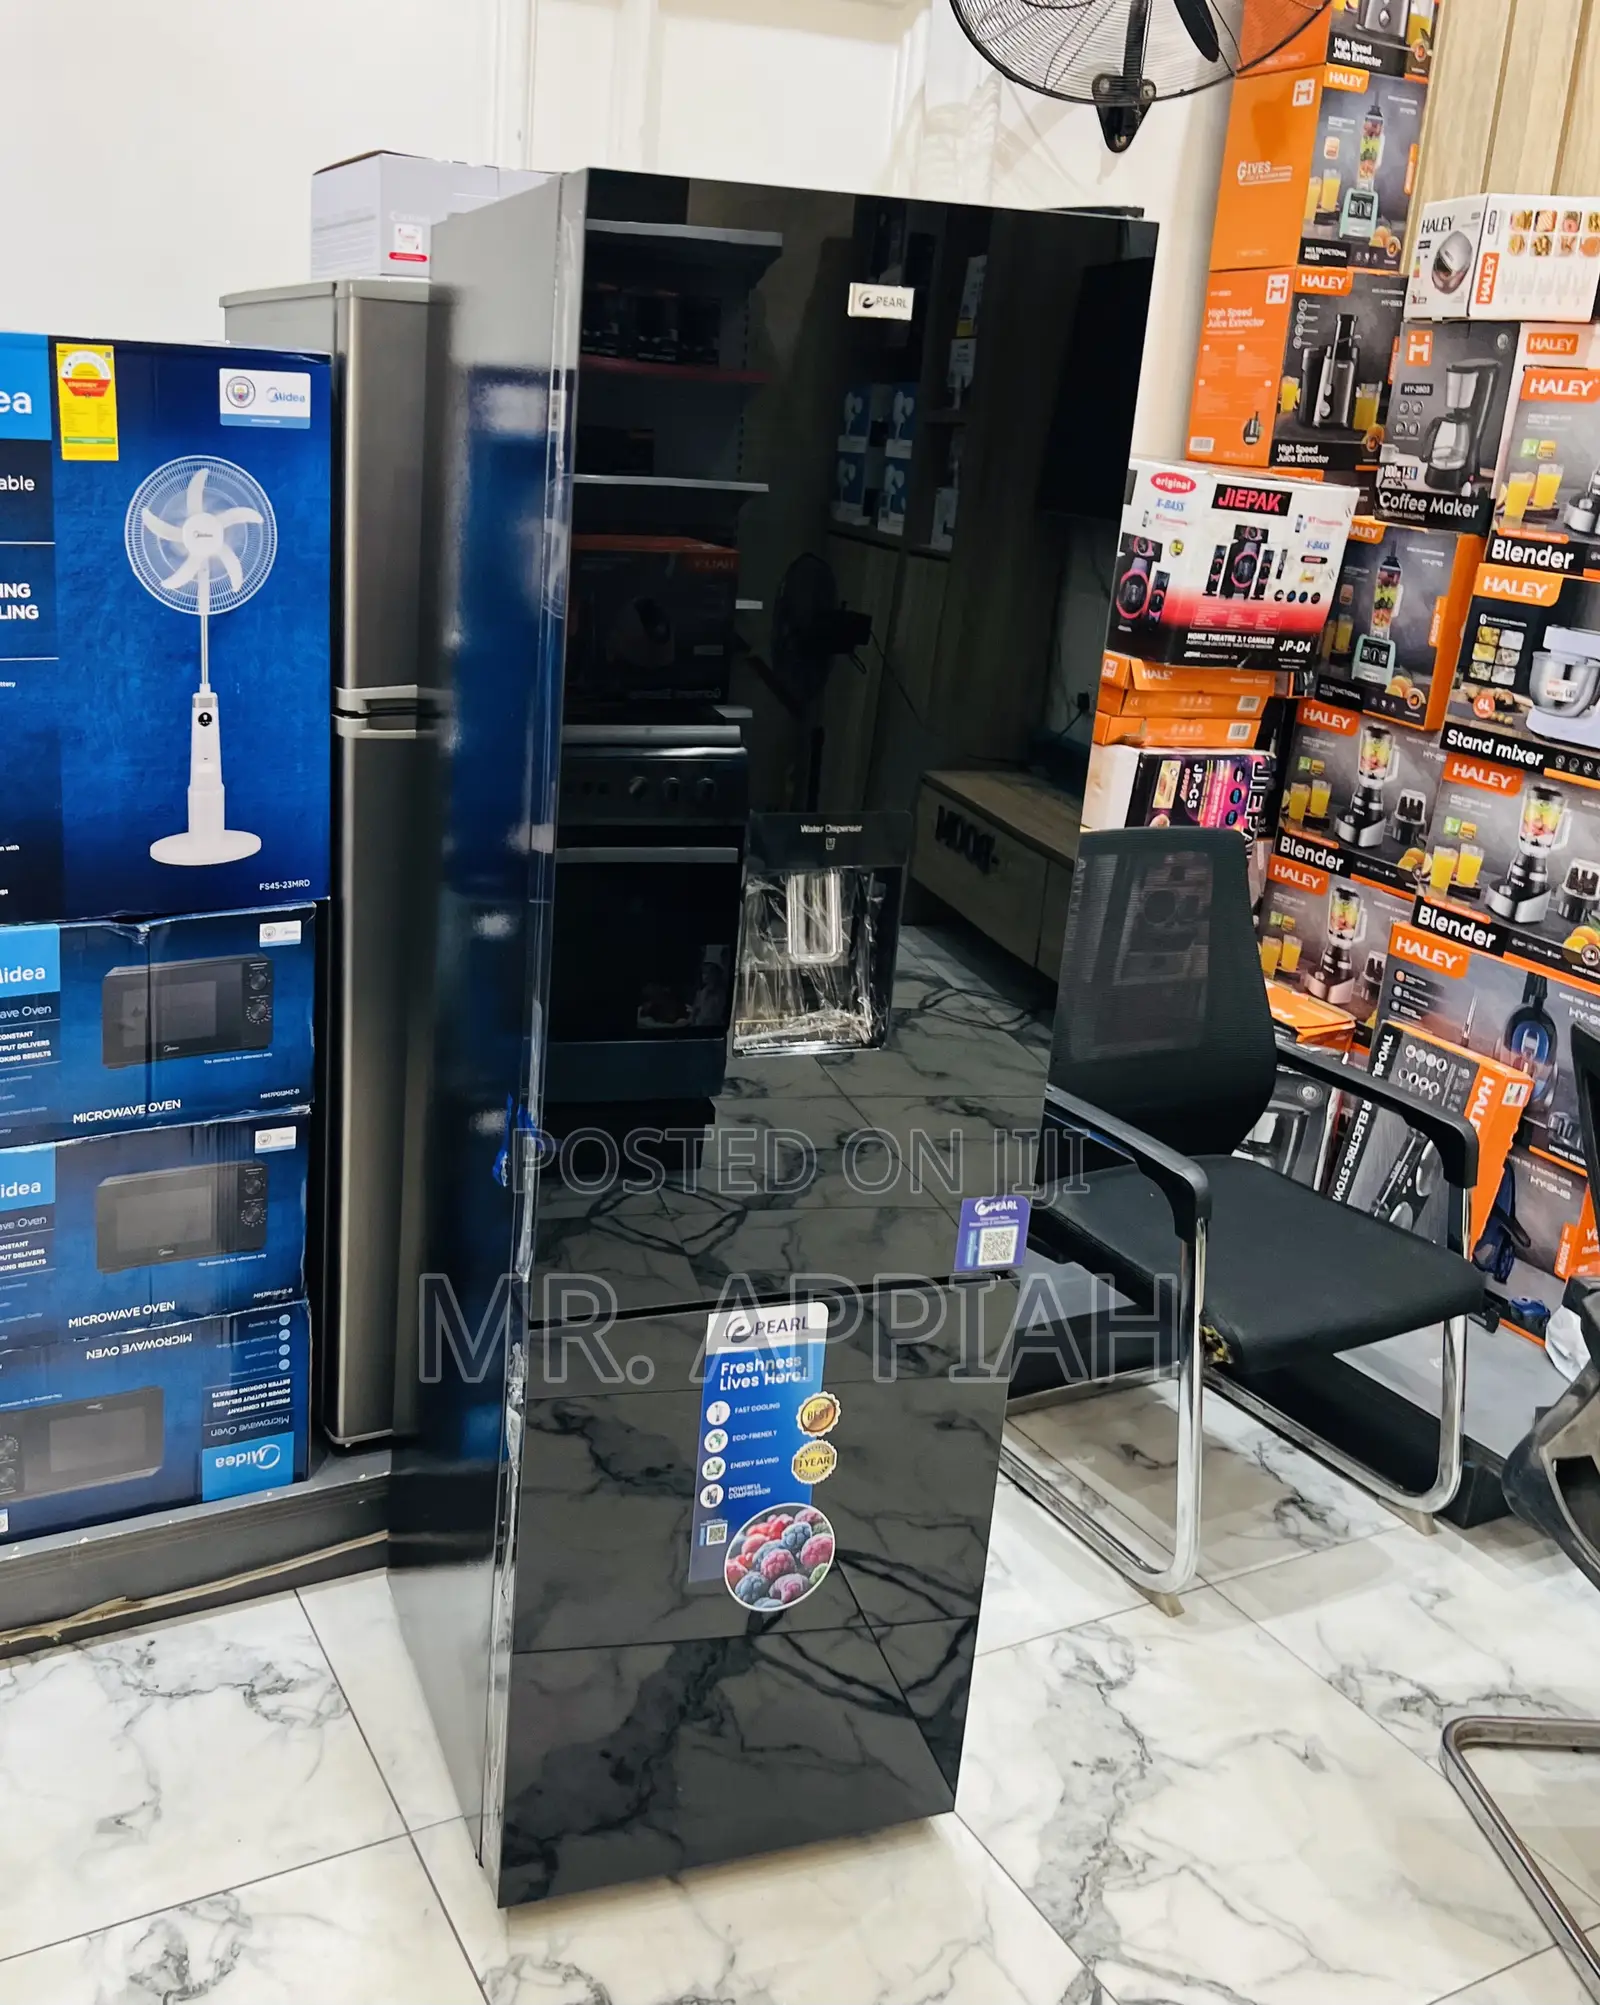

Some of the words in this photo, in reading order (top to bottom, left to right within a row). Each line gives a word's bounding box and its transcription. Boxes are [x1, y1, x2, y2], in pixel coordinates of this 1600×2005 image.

[1329, 72, 1364, 88] HALEY
[1237, 160, 1271, 180] GIVES
[1421, 215, 1455, 233] HALEY
[1301, 275, 1346, 290] HALEY
[1480, 256, 1496, 301] HALEY
[875, 295, 908, 309] PEARL
[1208, 308, 1226, 321] High
[1227, 307, 1252, 320] Speed
[1530, 337, 1574, 352] HALEY
[266, 387, 305, 404] Midea
[1529, 377, 1593, 397] HALEY
[1278, 444, 1295, 455] High
[1296, 445, 1319, 455] Speed
[1156, 477, 1191, 491] original
[1218, 487, 1282, 513] JIEPAK
[1379, 491, 1427, 512] Coffee
[1429, 497, 1479, 519] Maker
[1491, 538, 1575, 570] Blender
[1483, 575, 1548, 599] HALEY
[1279, 640, 1311, 653] JP-D4
[1142, 668, 1173, 680] HALE
[1303, 708, 1350, 730] HALEY
[1446, 728, 1495, 755] Stand
[1496, 743, 1544, 768] mixer
[1452, 761, 1512, 791] HALEY
[1187, 763, 1203, 809] JP-C5
[800, 825, 824, 834] Water
[825, 825, 862, 835] Dispenser
[1280, 836, 1344, 871] Blender
[259, 879, 310, 891] FS45-23MRD
[1274, 865, 1321, 888] HALEY
[1418, 905, 1497, 949] Blender
[1396, 936, 1457, 971] HALEY
[22, 1005, 52, 1016] Oven
[17, 1040, 50, 1050] DELIVERS
[22, 1050, 51, 1060] RESULTS
[73, 1103, 146, 1124] MICROWAVE
[147, 1099, 181, 1112] OVEN
[1344, 1113, 1369, 1167] ELECTRIC
[17, 1216, 47, 1228] Oven
[68, 1307, 141, 1329] MICROWAVE
[143, 1301, 176, 1315] OVEN
[754, 1316, 809, 1336] PEARL
[122, 1333, 192, 1353] MICROWAVE
[86, 1346, 120, 1360] OVEN
[721, 1356, 802, 1376] Freshness
[720, 1375, 759, 1391] Lives
[764, 1367, 808, 1386] Here!
[735, 1406, 750, 1414] FAST
[751, 1402, 780, 1413] COOLING
[210, 1423, 237, 1437] Oven
[239, 1414, 290, 1433] Microwave
[732, 1430, 778, 1442] ECO-FRIENDLY
[215, 1444, 281, 1470] Midea
[730, 1459, 755, 1469] ENERGY
[756, 1456, 779, 1467] SAVING
[805, 1456, 830, 1468] YEAR
